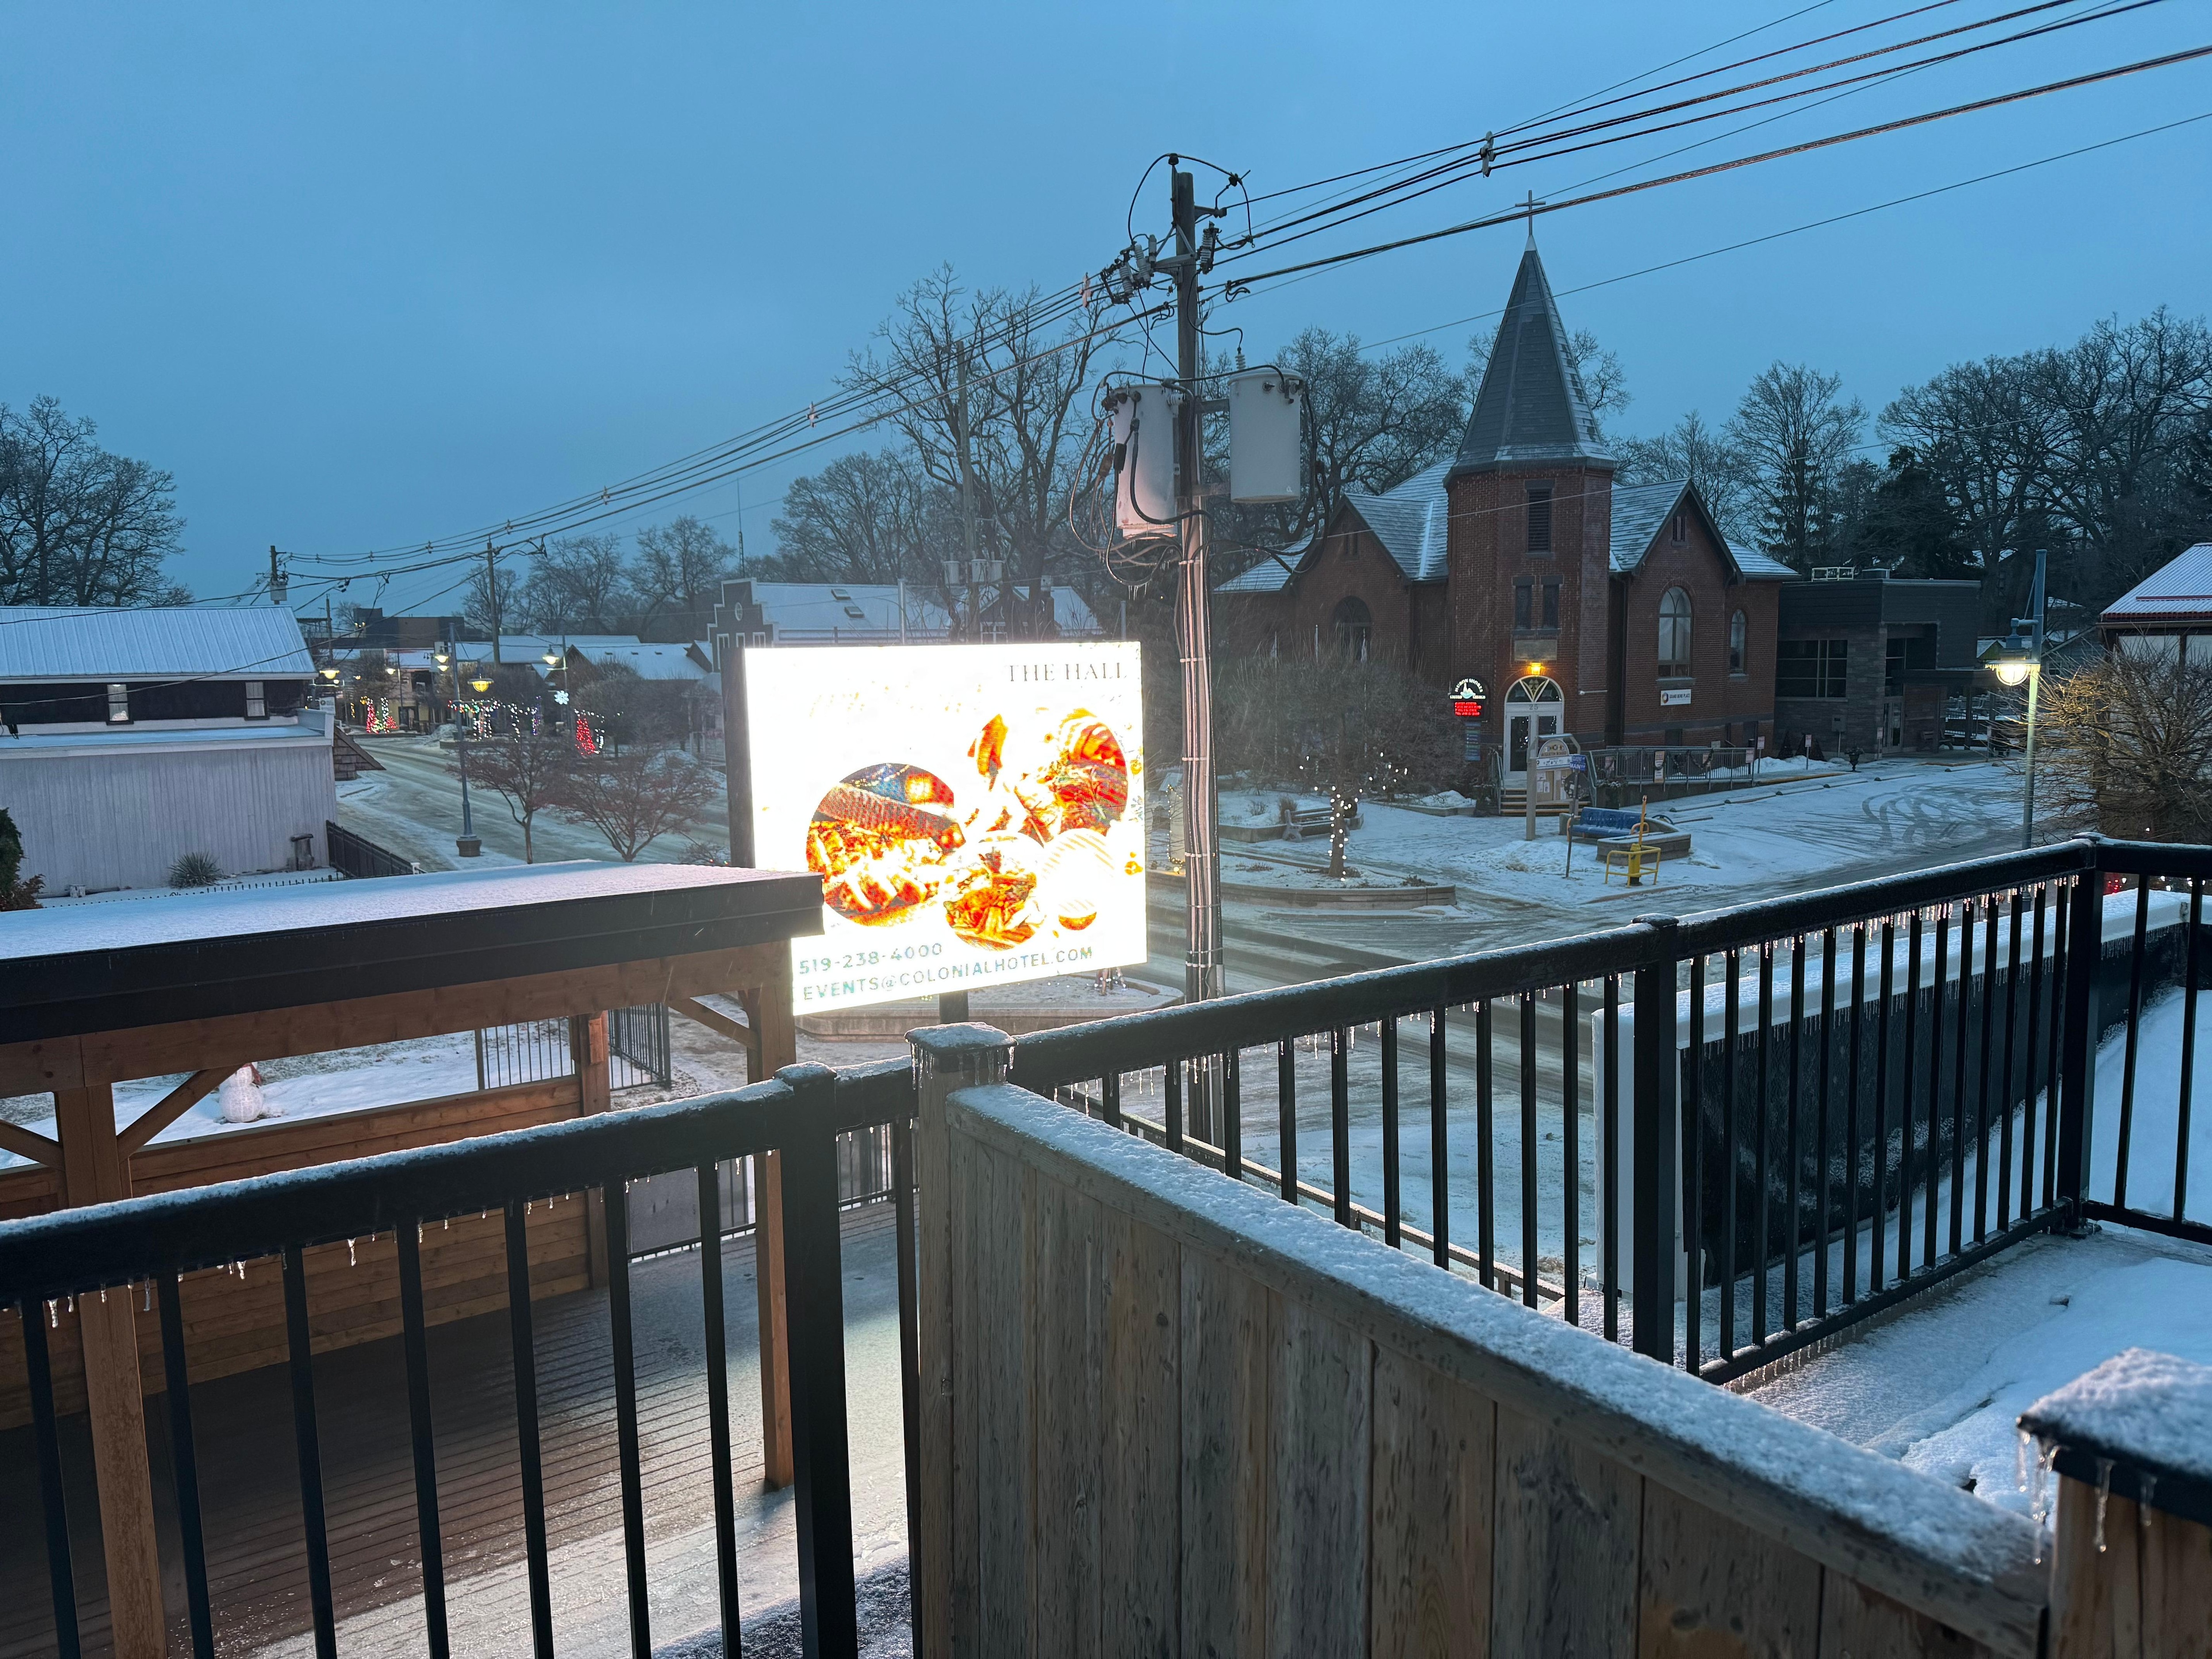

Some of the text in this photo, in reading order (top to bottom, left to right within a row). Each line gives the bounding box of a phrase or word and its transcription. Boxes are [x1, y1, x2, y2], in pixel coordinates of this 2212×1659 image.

[1008, 662, 1127, 682] THE HALL
[799, 942, 943, 975] 519-238-4000
[803, 946, 1093, 1001] EVENTS@COLONIALHOTEL.COM
